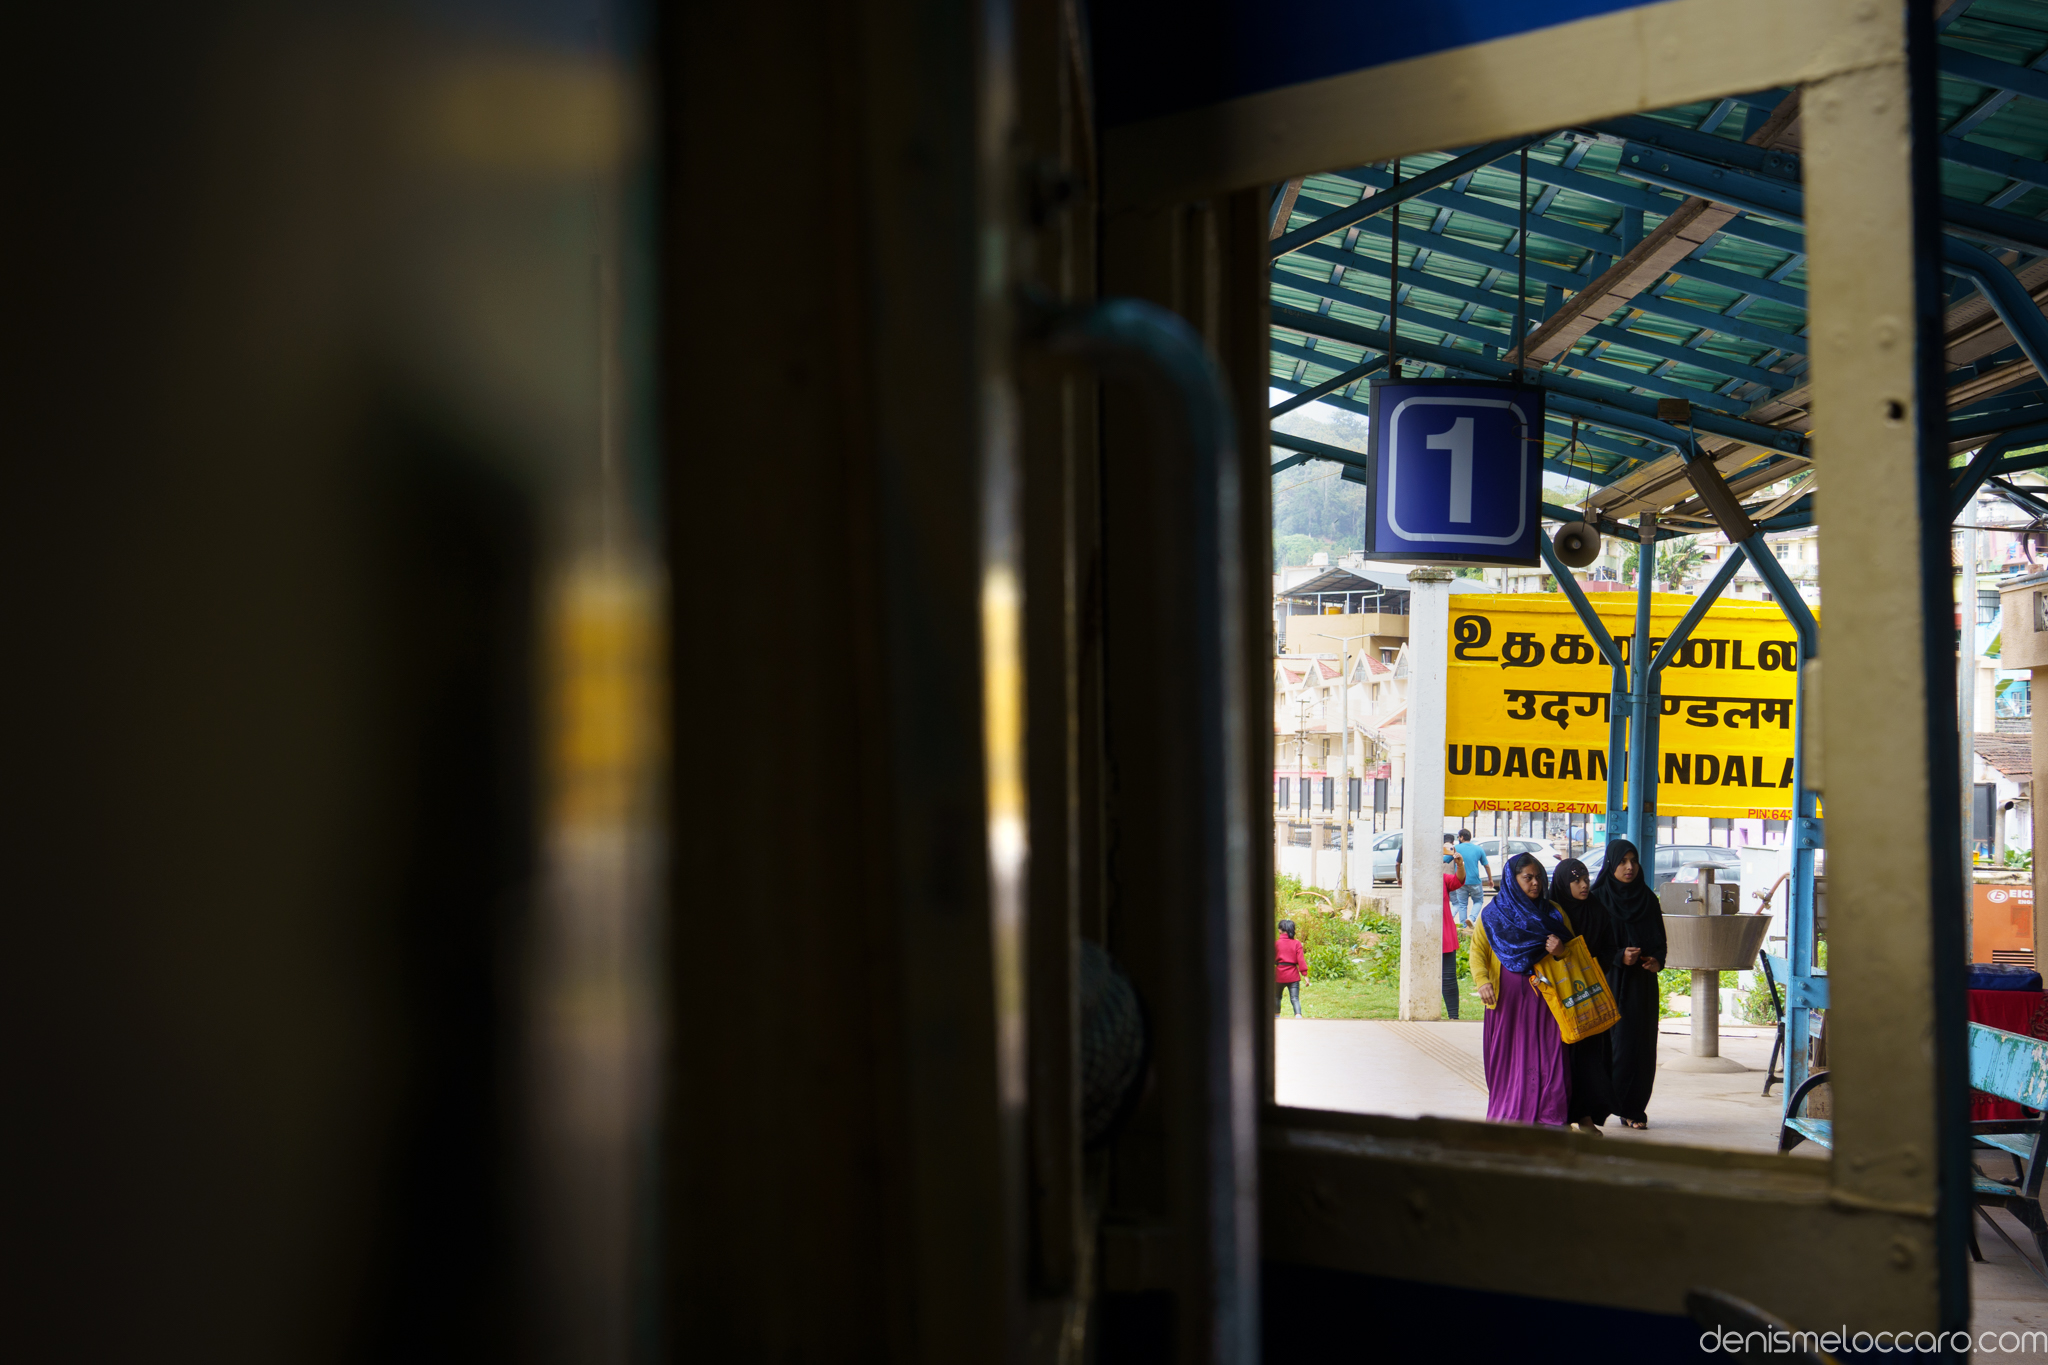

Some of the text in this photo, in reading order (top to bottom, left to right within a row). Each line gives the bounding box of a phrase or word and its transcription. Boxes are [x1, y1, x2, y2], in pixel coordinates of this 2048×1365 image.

[1426, 416, 1474, 524] 1
[1454, 614, 1798, 672] உதகமண்டல
[1504, 688, 1794, 730] उदगण्डलम
[1447, 743, 1795, 788] UDAGAMNDALA
[1748, 809, 1793, 821] PIN:643
